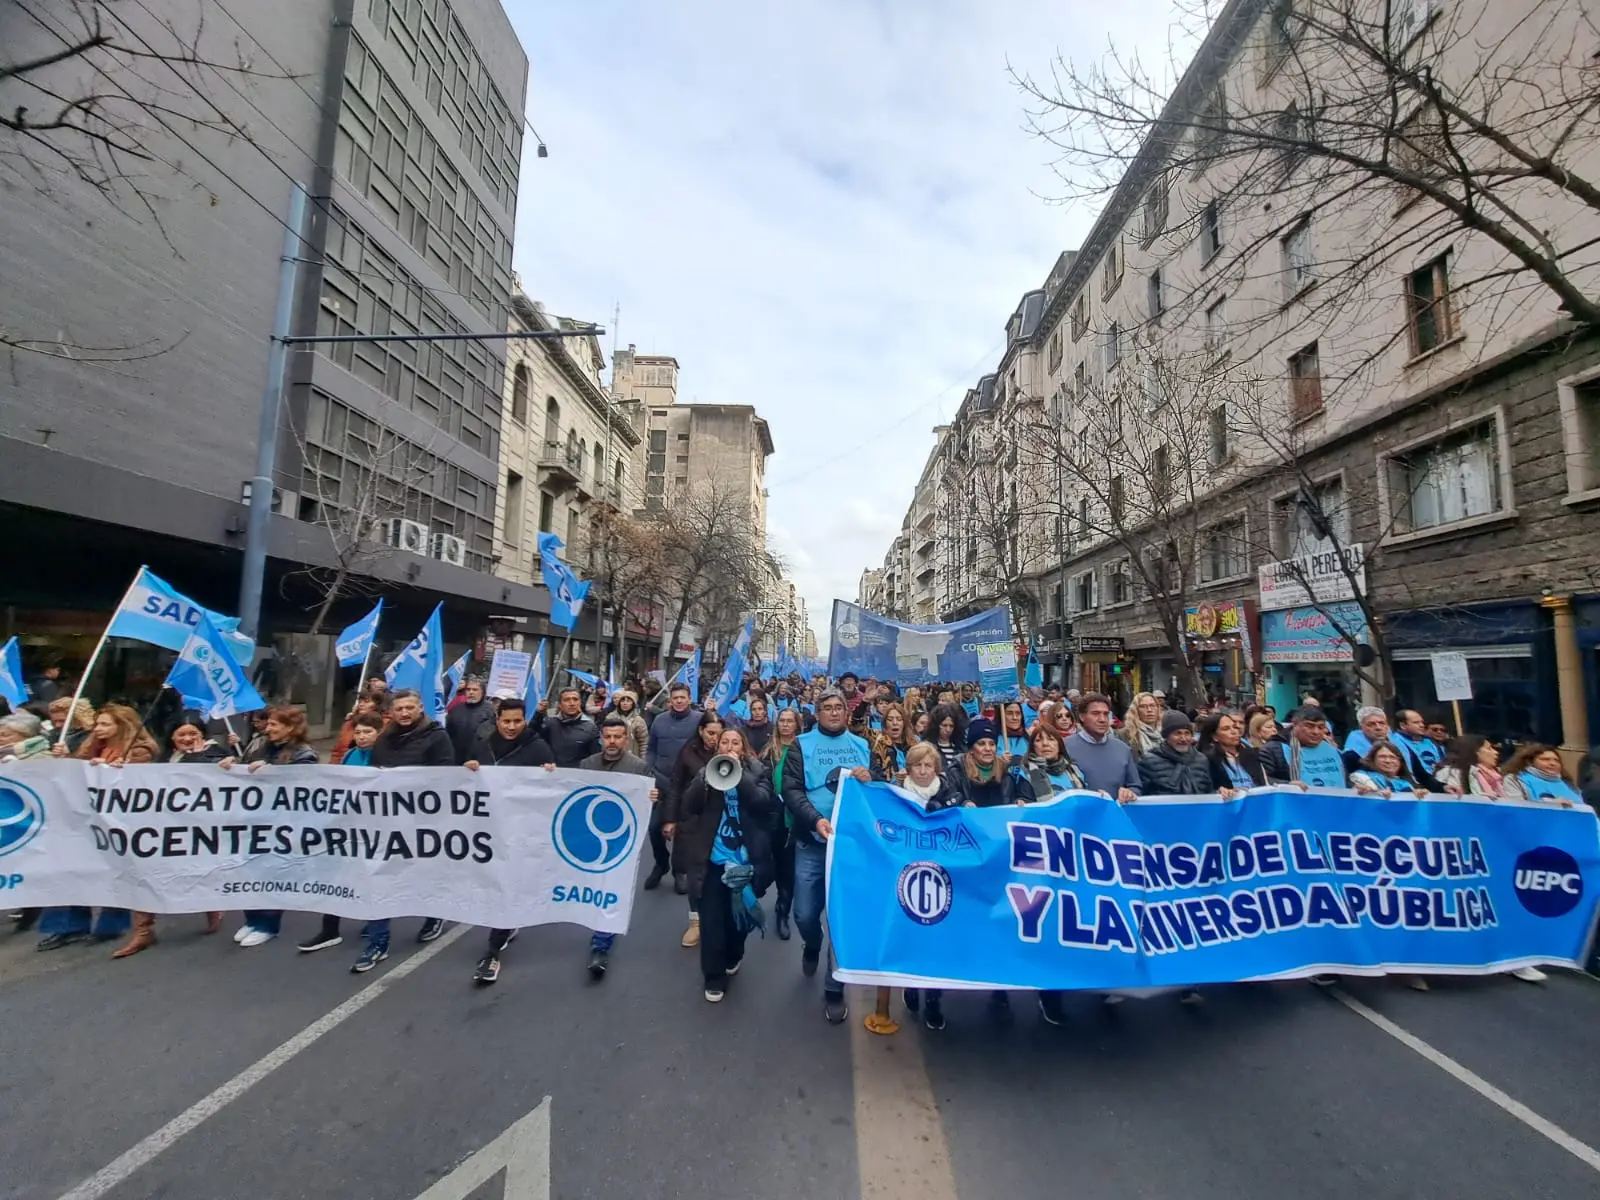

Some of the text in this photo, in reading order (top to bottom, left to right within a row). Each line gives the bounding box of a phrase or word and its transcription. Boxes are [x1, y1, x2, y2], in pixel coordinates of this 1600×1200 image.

[1312, 547, 1361, 576] PERERA
[143, 595, 202, 627] SAD
[88, 786, 490, 817] SINDICATO ARGENTINO DE
[89, 824, 493, 864] DOCENTES PRIVADOS
[1007, 821, 1078, 881] EN
[1080, 832, 1226, 893] DENSA
[1228, 831, 1285, 881] DE
[1327, 831, 1490, 880] ESCUELA
[222, 881, 300, 894] SECCIONAL
[303, 881, 354, 898] CÓRDOBA
[552, 885, 618, 909] SADOP
[1515, 869, 1581, 895] UEPC
[1006, 883, 1054, 943] Y
[1058, 889, 1137, 953] LA
[1130, 882, 1350, 956] NIVERSIDA
[1343, 875, 1498, 931] PÚBLICA
